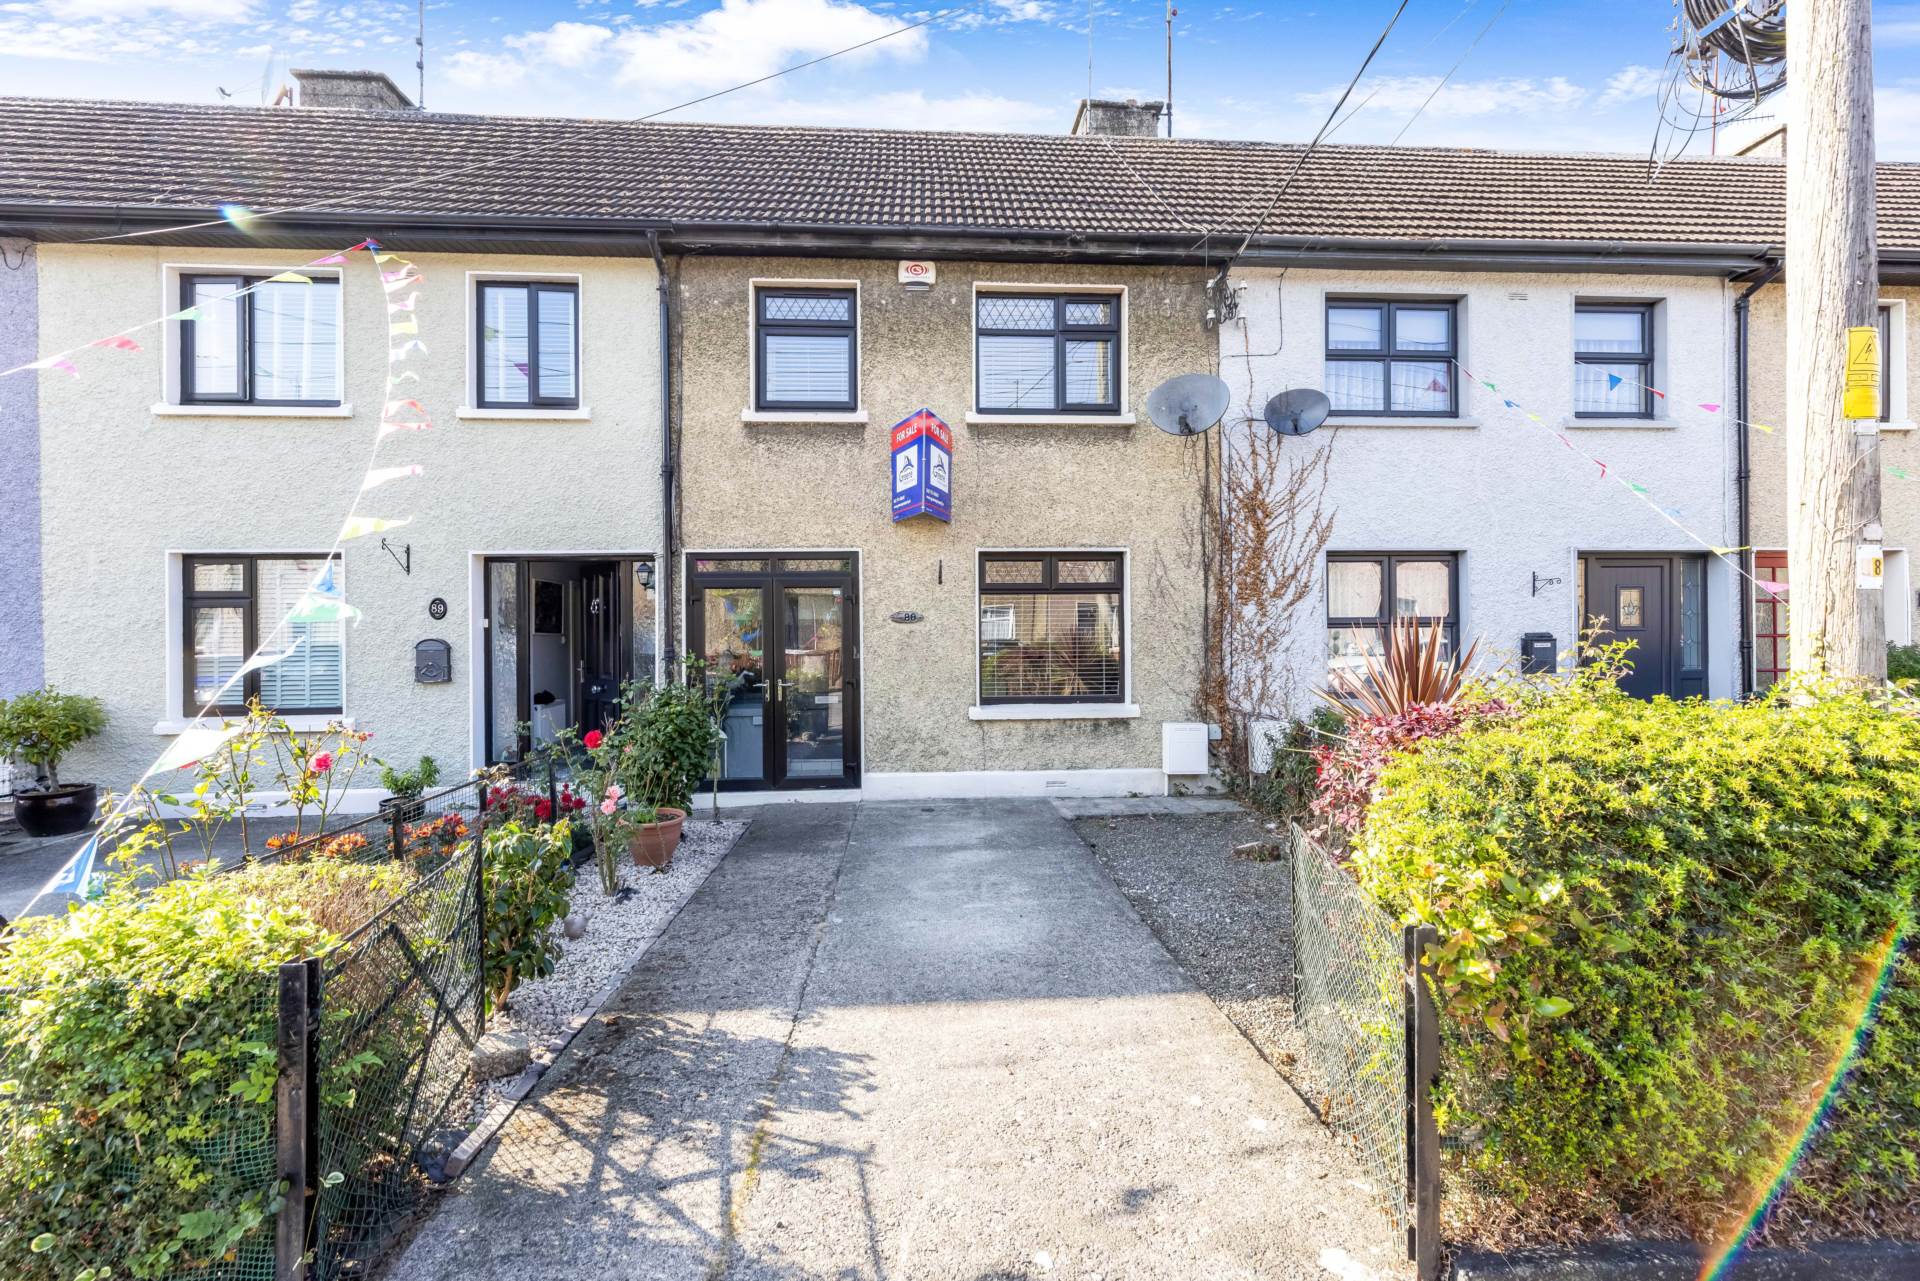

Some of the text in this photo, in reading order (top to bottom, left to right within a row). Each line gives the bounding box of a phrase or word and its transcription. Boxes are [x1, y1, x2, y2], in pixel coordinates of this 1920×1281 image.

[896, 423, 917, 443] FOR SALE
[931, 423, 949, 444] FOR SALE
[1874, 559, 1882, 576] 8
[431, 603, 444, 613] 89
